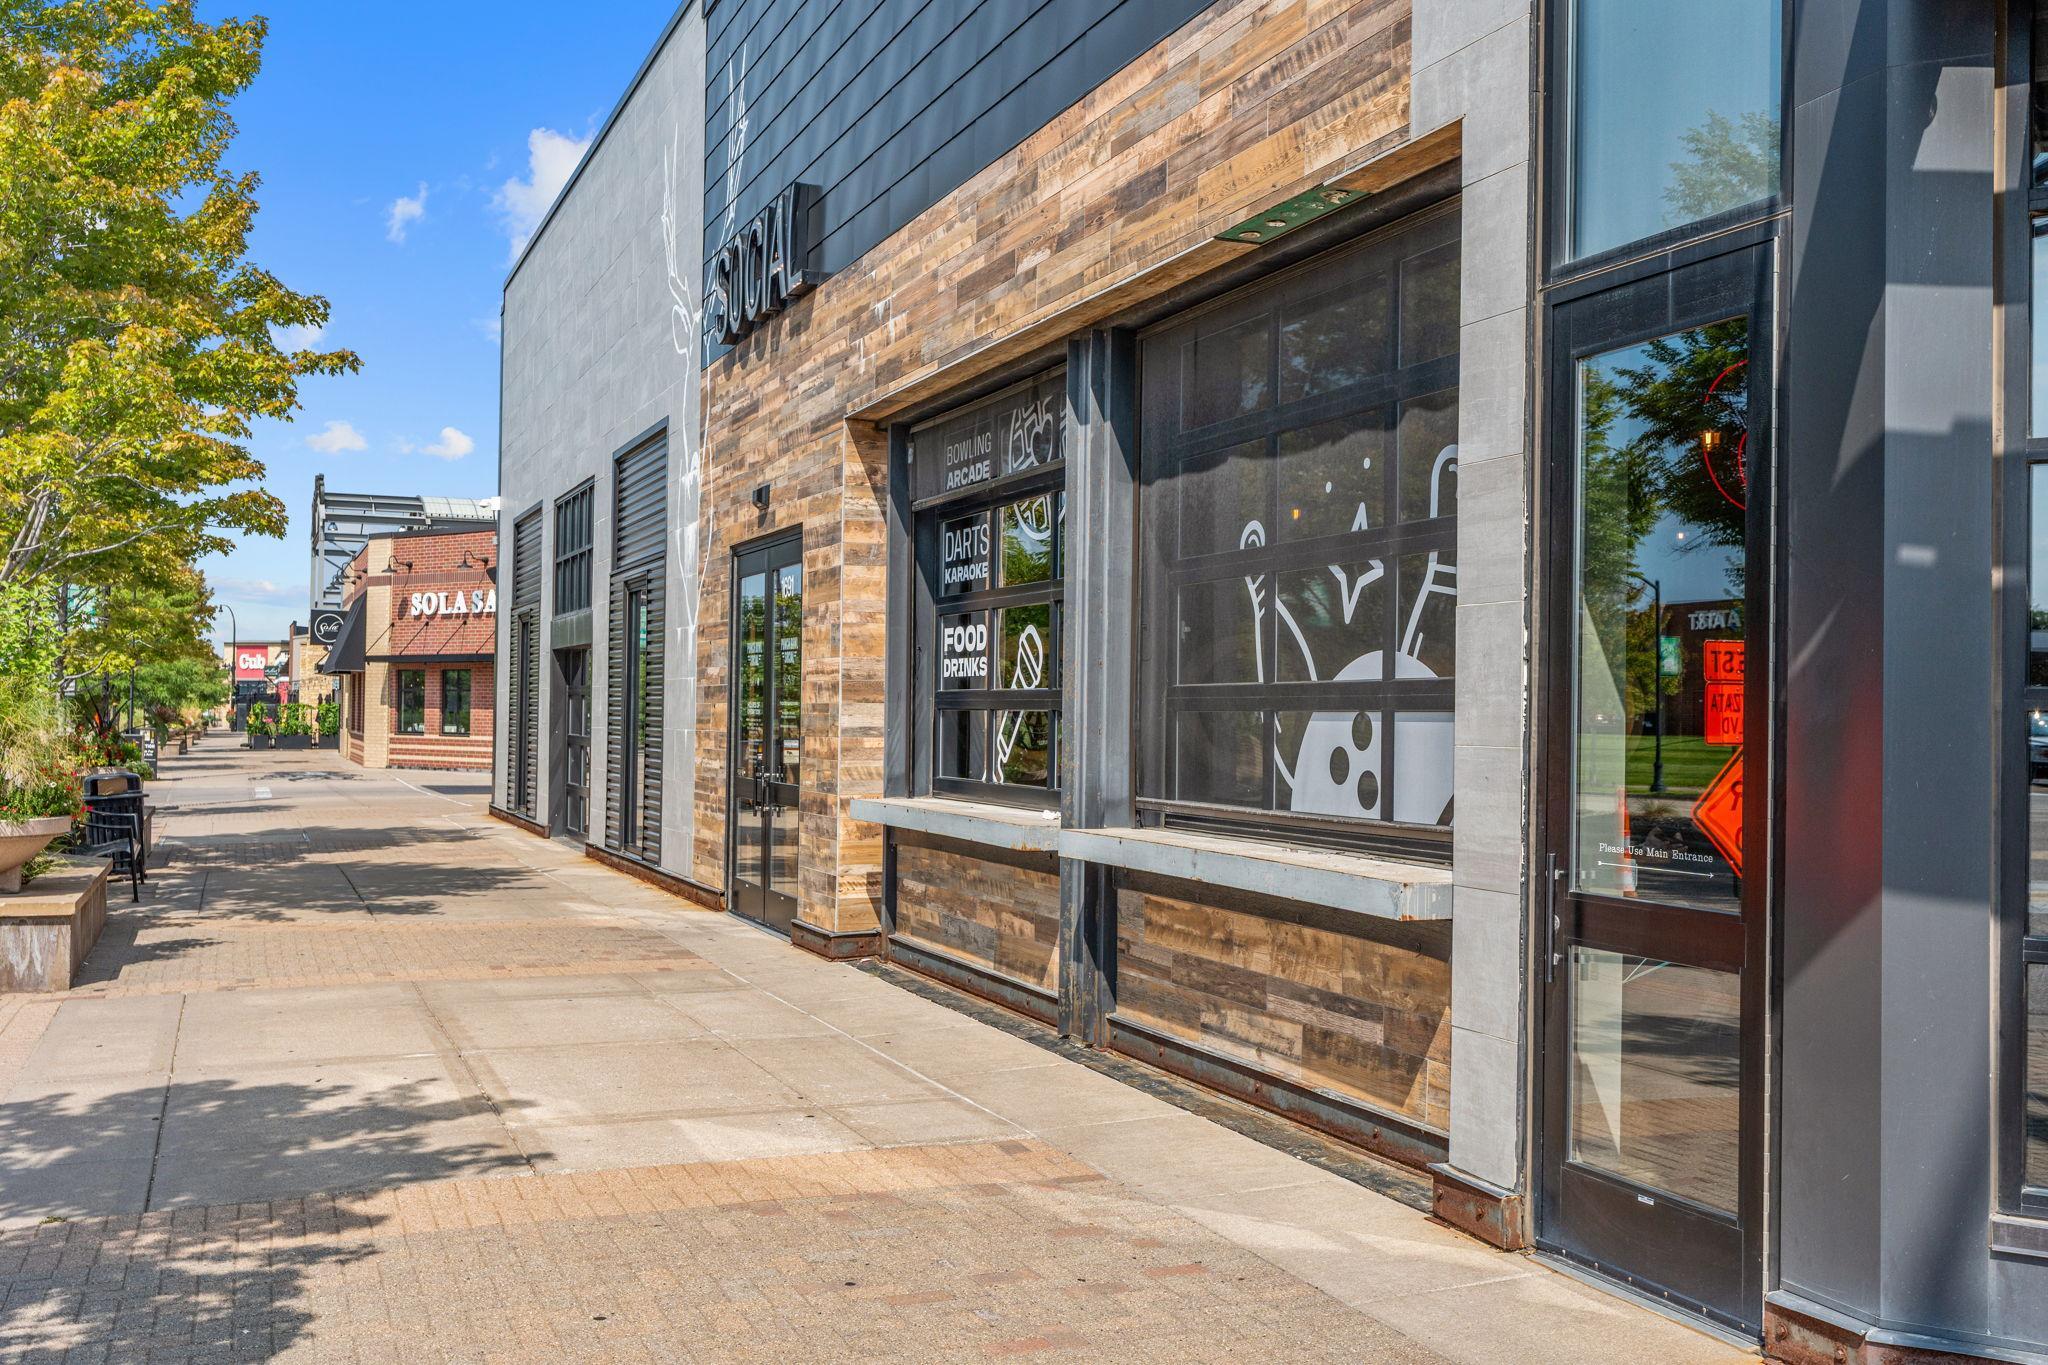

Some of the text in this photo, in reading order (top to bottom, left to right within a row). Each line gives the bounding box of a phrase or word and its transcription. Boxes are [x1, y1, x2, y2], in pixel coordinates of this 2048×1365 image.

[715, 181, 808, 345] SOCIAL
[946, 432, 991, 465] BOWLING
[946, 460, 990, 490] ARCADE
[945, 523, 990, 562] DARTS
[944, 562, 988, 584] KARAOKE
[411, 589, 496, 616] SOLA SA
[944, 624, 987, 653] FOOD
[239, 654, 266, 670] Cub
[943, 656, 988, 678] DRINKS
[1599, 842, 1714, 863] Please Use Main Entrance
